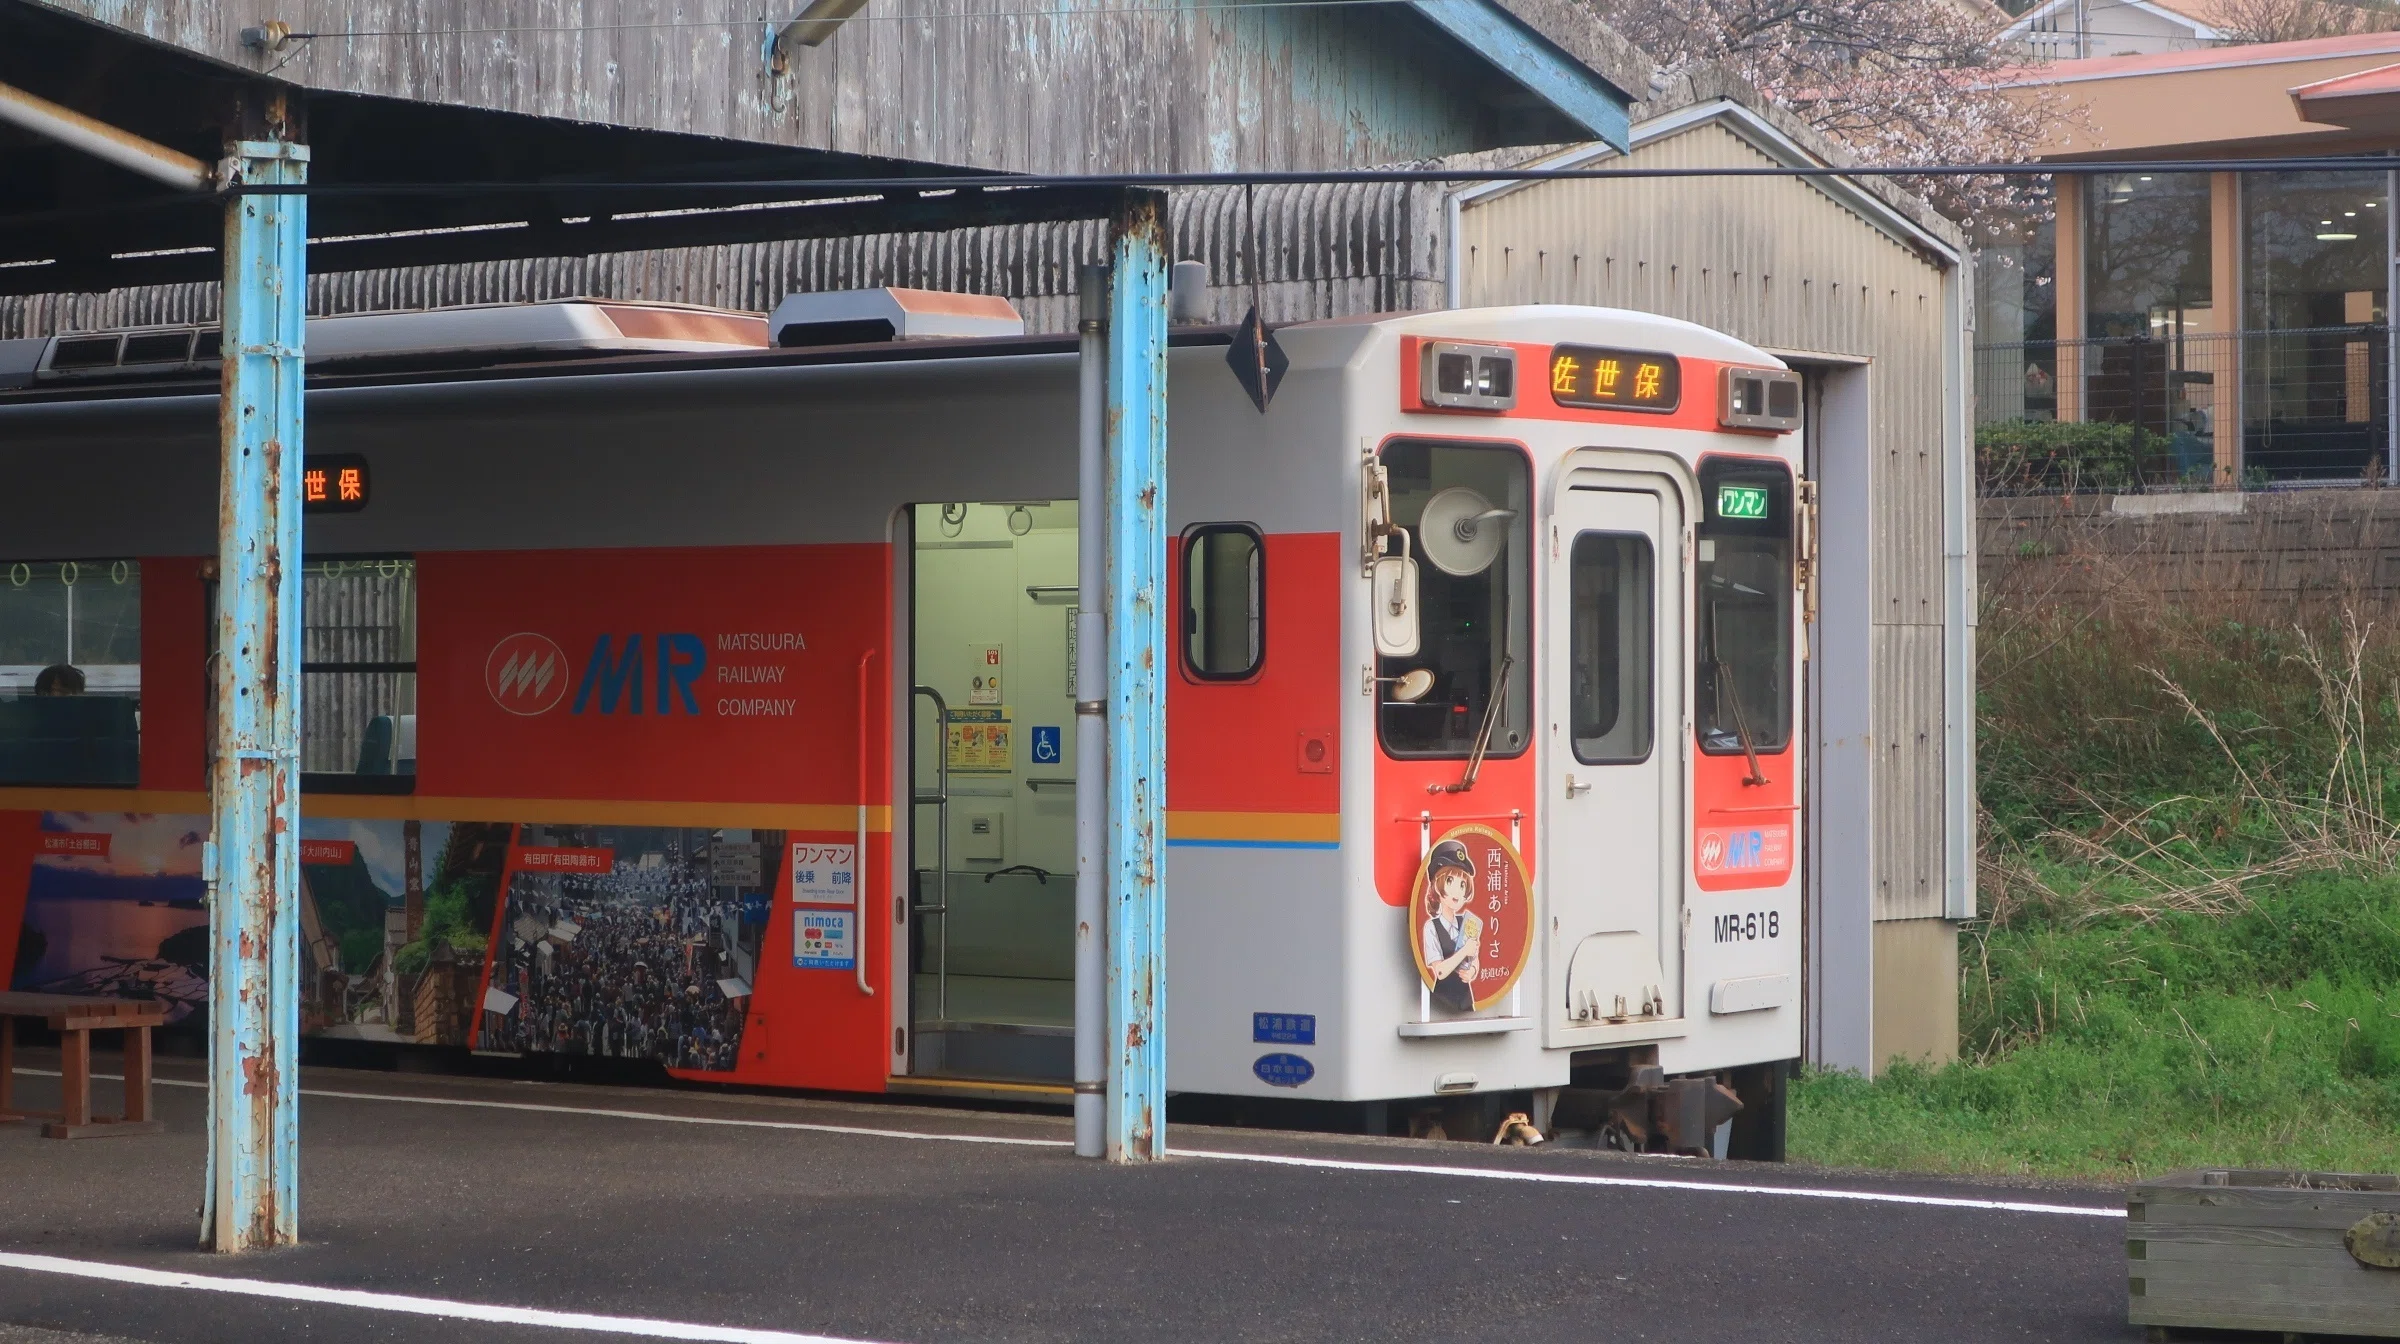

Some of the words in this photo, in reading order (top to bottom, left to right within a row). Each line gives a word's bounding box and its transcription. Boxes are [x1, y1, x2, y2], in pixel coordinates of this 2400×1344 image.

[1552, 355, 1661, 399] 佐世保
[1723, 489, 1765, 515] ワンマン
[717, 633, 806, 651] MATSUURA
[571, 633, 707, 716] MR
[717, 665, 786, 683] RAILWAY
[717, 698, 797, 716] COMPANY
[795, 847, 852, 864] ワンマン
[1725, 830, 1763, 868] MR
[524, 853, 600, 867] 有田町「有田陶器市」
[795, 870, 815, 884] 後乗
[831, 871, 852, 885] 前降
[1486, 847, 1502, 958] 西浦ありさ
[804, 913, 843, 928] nimoca
[1714, 910, 1779, 943] MR-618
